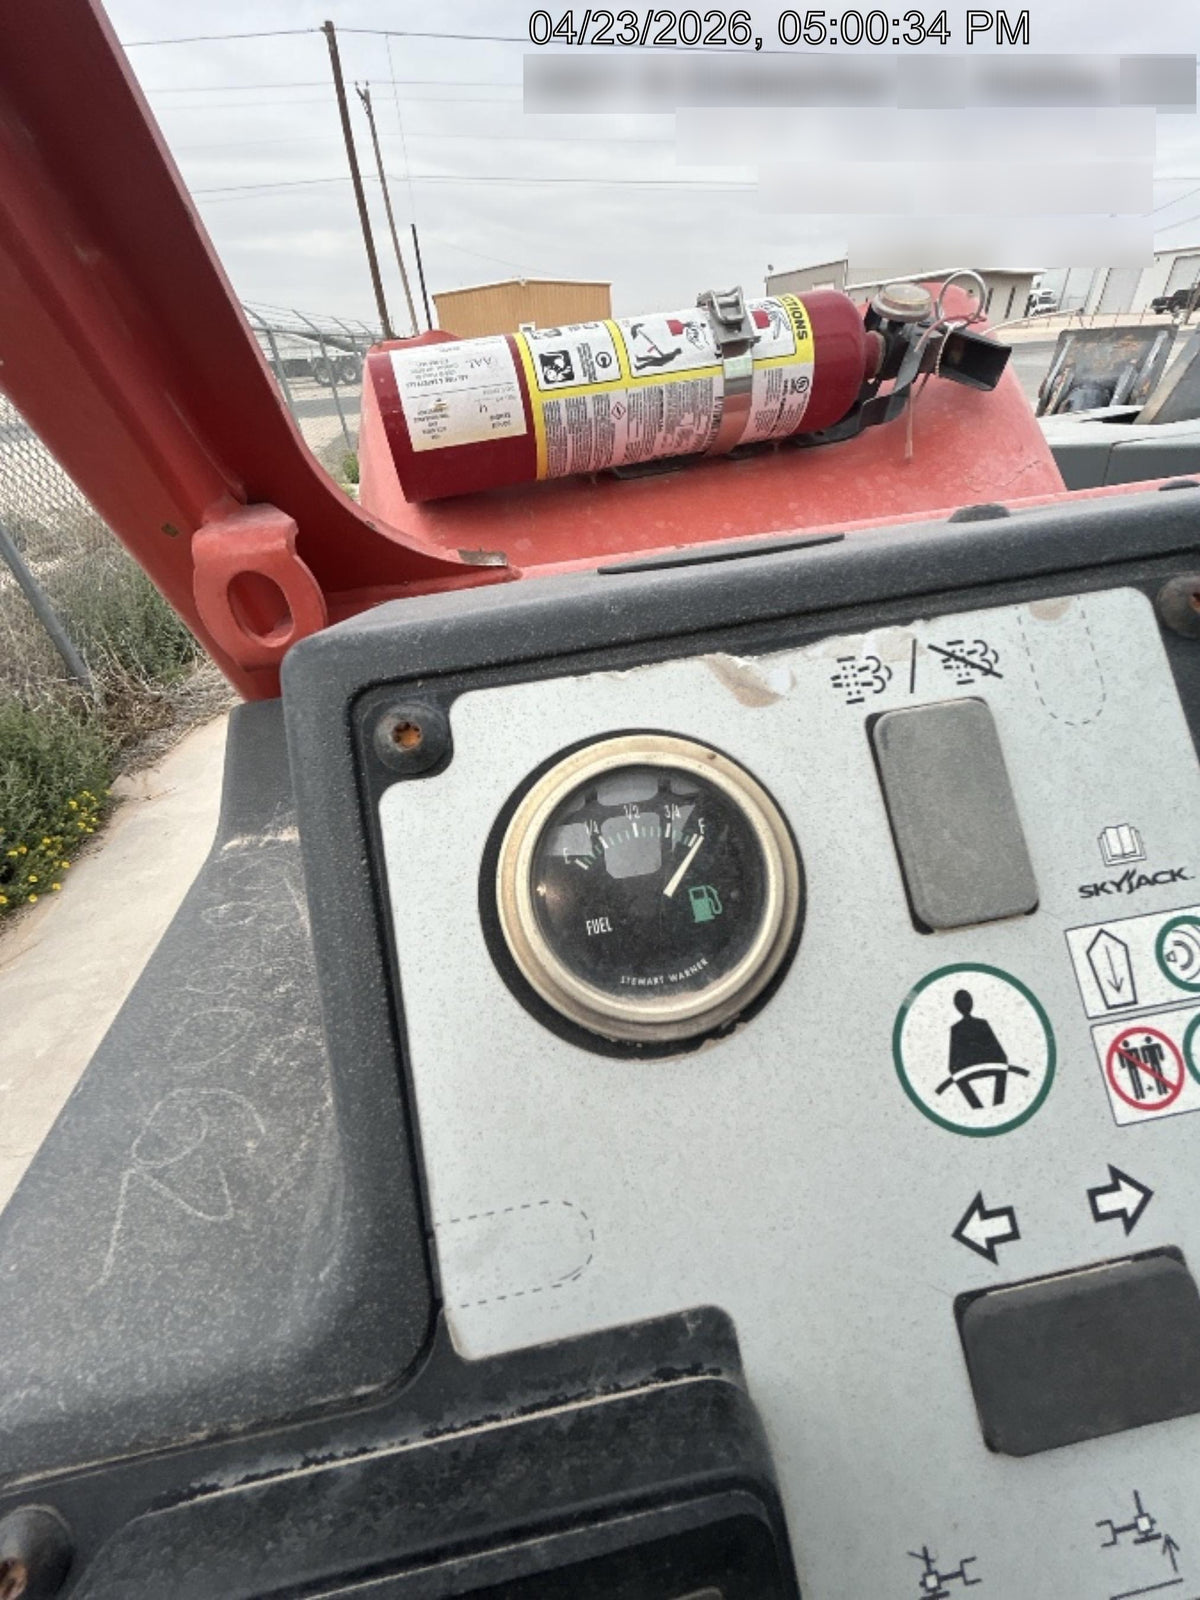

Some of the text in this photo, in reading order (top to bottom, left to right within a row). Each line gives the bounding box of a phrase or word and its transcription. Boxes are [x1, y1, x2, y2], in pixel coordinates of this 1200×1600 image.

[623, 803, 641, 820] 1/2
[664, 803, 681, 821] 3/4
[1078, 868, 1190, 899] SKYJACK
[585, 916, 613, 936] FUEL
[667, 957, 709, 983] WARNER
